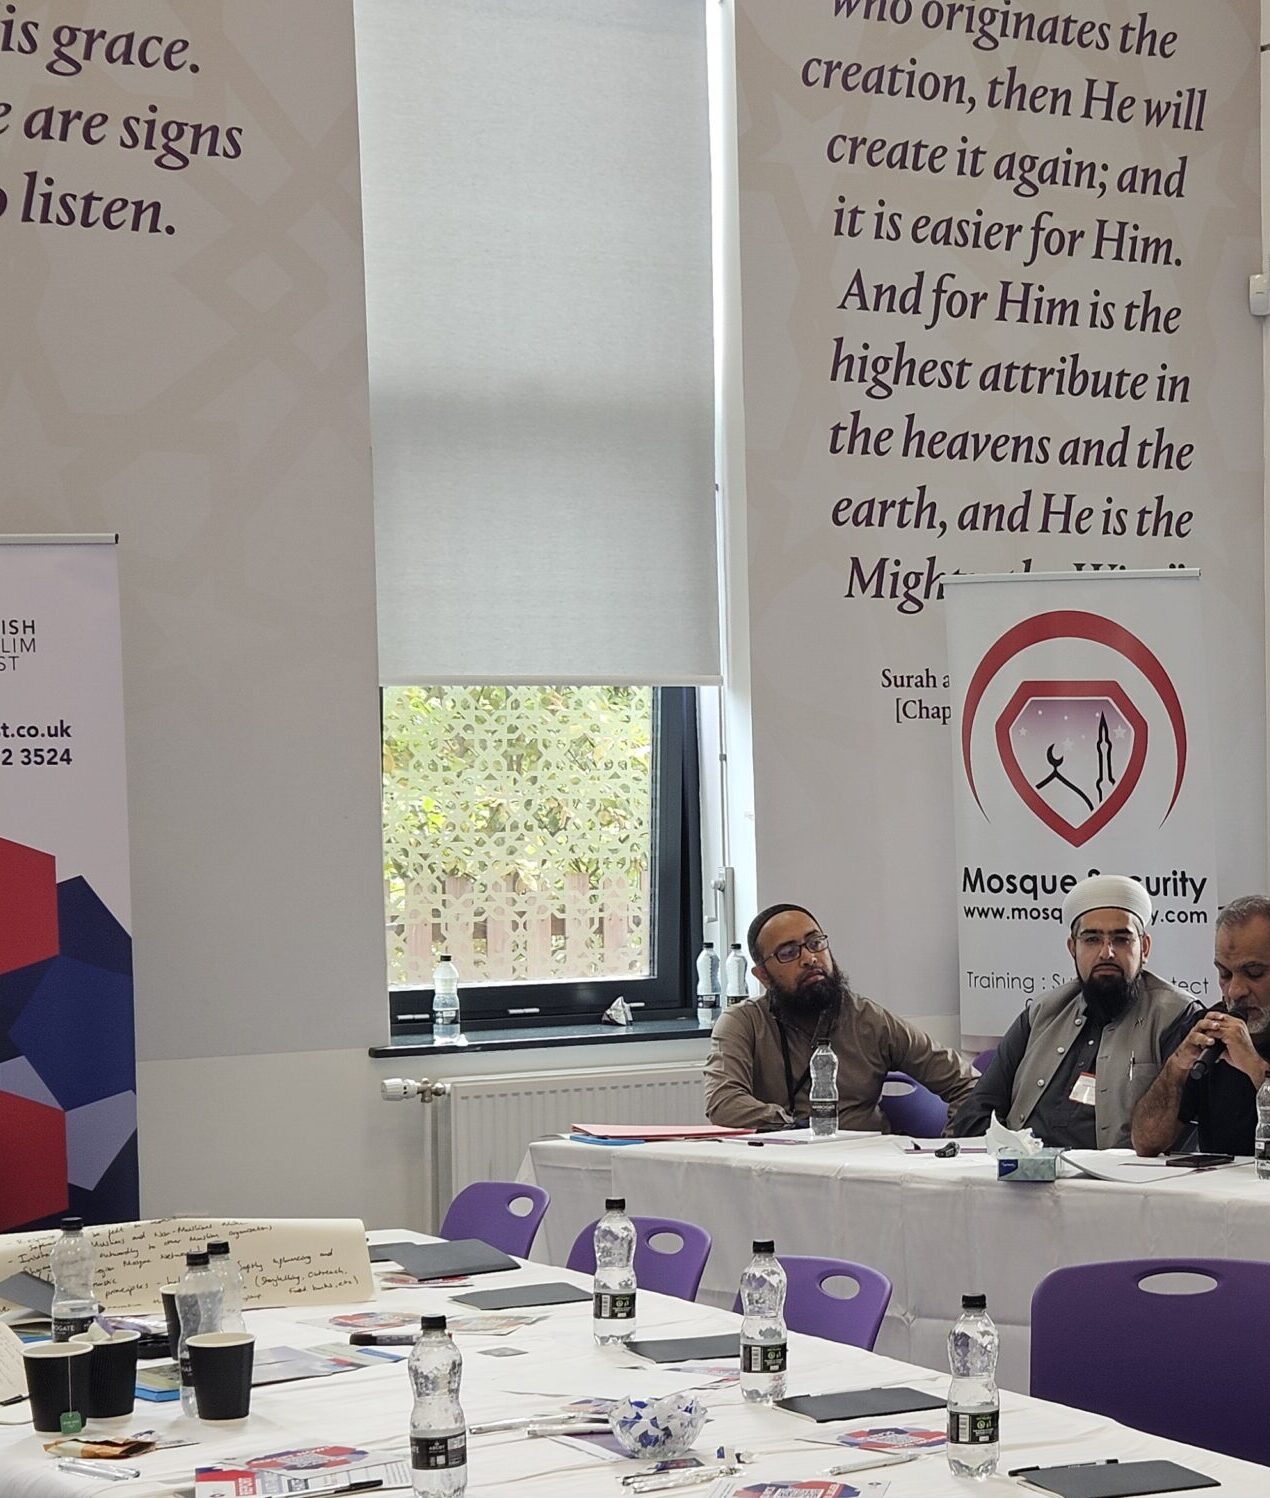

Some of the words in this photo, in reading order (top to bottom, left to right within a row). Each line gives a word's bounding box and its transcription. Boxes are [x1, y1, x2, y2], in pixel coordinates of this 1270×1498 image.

[46, 25, 200, 76] grace.
[921, 0, 1111, 51] originates
[1119, 13, 1178, 59] the
[801, 57, 977, 114] creation,
[987, 66, 1072, 117] then
[1081, 78, 1136, 123] He
[1144, 88, 1207, 132] will
[24, 106, 109, 146] are
[120, 104, 243, 171] signs
[826, 133, 949, 174] create
[956, 135, 988, 178] it
[994, 147, 1108, 199] again;
[1117, 156, 1188, 199] and
[21, 171, 175, 236] listen.
[833, 195, 866, 237] it
[874, 199, 902, 241] is
[911, 208, 1023, 252] easier
[1023, 211, 1085, 267] for
[1091, 218, 1183, 267] Him.
[836, 267, 925, 316] And
[924, 273, 988, 330] for
[994, 280, 1080, 328] Him
[1088, 289, 1116, 331] is
[1124, 290, 1182, 335] the
[829, 336, 972, 400] highest
[979, 353, 1149, 401] attribute
[1156, 363, 1190, 402] in
[829, 410, 894, 457] the
[902, 413, 1050, 466] heavens
[1058, 425, 1130, 469] and
[1136, 427, 1194, 472] the
[831, 485, 948, 539] earth,
[957, 490, 1032, 533] and
[1037, 493, 1094, 535] He
[1101, 496, 1128, 537] is
[1135, 494, 1193, 539] the
[844, 555, 983, 615] Migh
[1, 638, 36, 653] LIM
[2, 619, 36, 635] ISH
[881, 668, 938, 689] Surah
[0, 719, 72, 738] t.co.uk
[20, 748, 73, 765] 3524
[962, 867, 1077, 901] Mosque
[1087, 869, 1207, 904] urity
[967, 971, 1035, 993] Training
